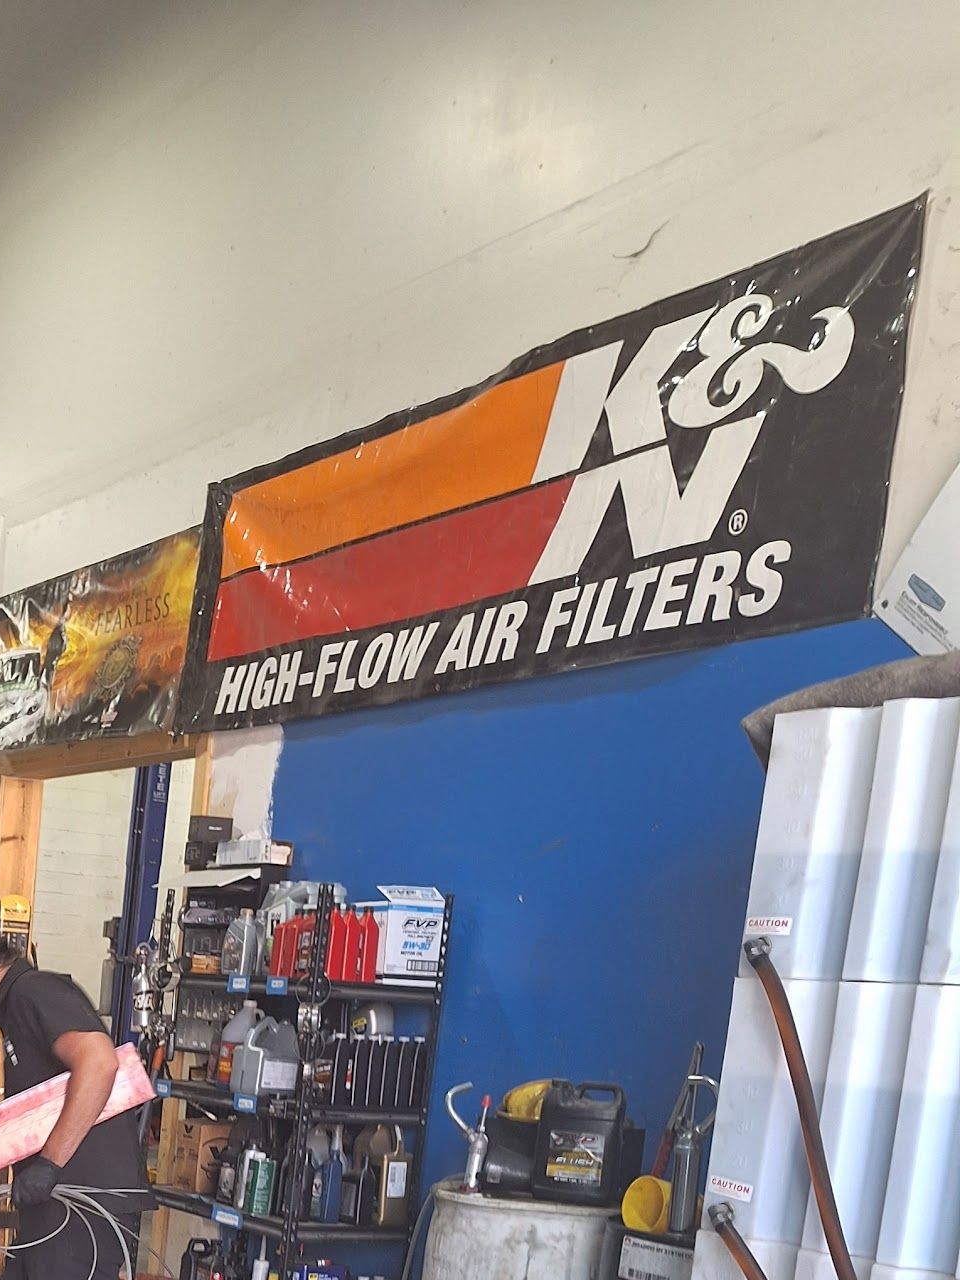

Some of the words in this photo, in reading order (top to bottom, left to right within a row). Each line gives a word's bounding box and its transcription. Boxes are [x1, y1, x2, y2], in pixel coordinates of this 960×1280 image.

[94, 592, 170, 637] FEARLESS
[214, 621, 440, 716] HIGH-FLOW
[434, 599, 529, 676] AIR
[535, 539, 792, 655] FILTERS
[403, 919, 438, 928] FVP
[748, 919, 789, 927] CAUTION
[711, 1177, 750, 1194] CAUTION
